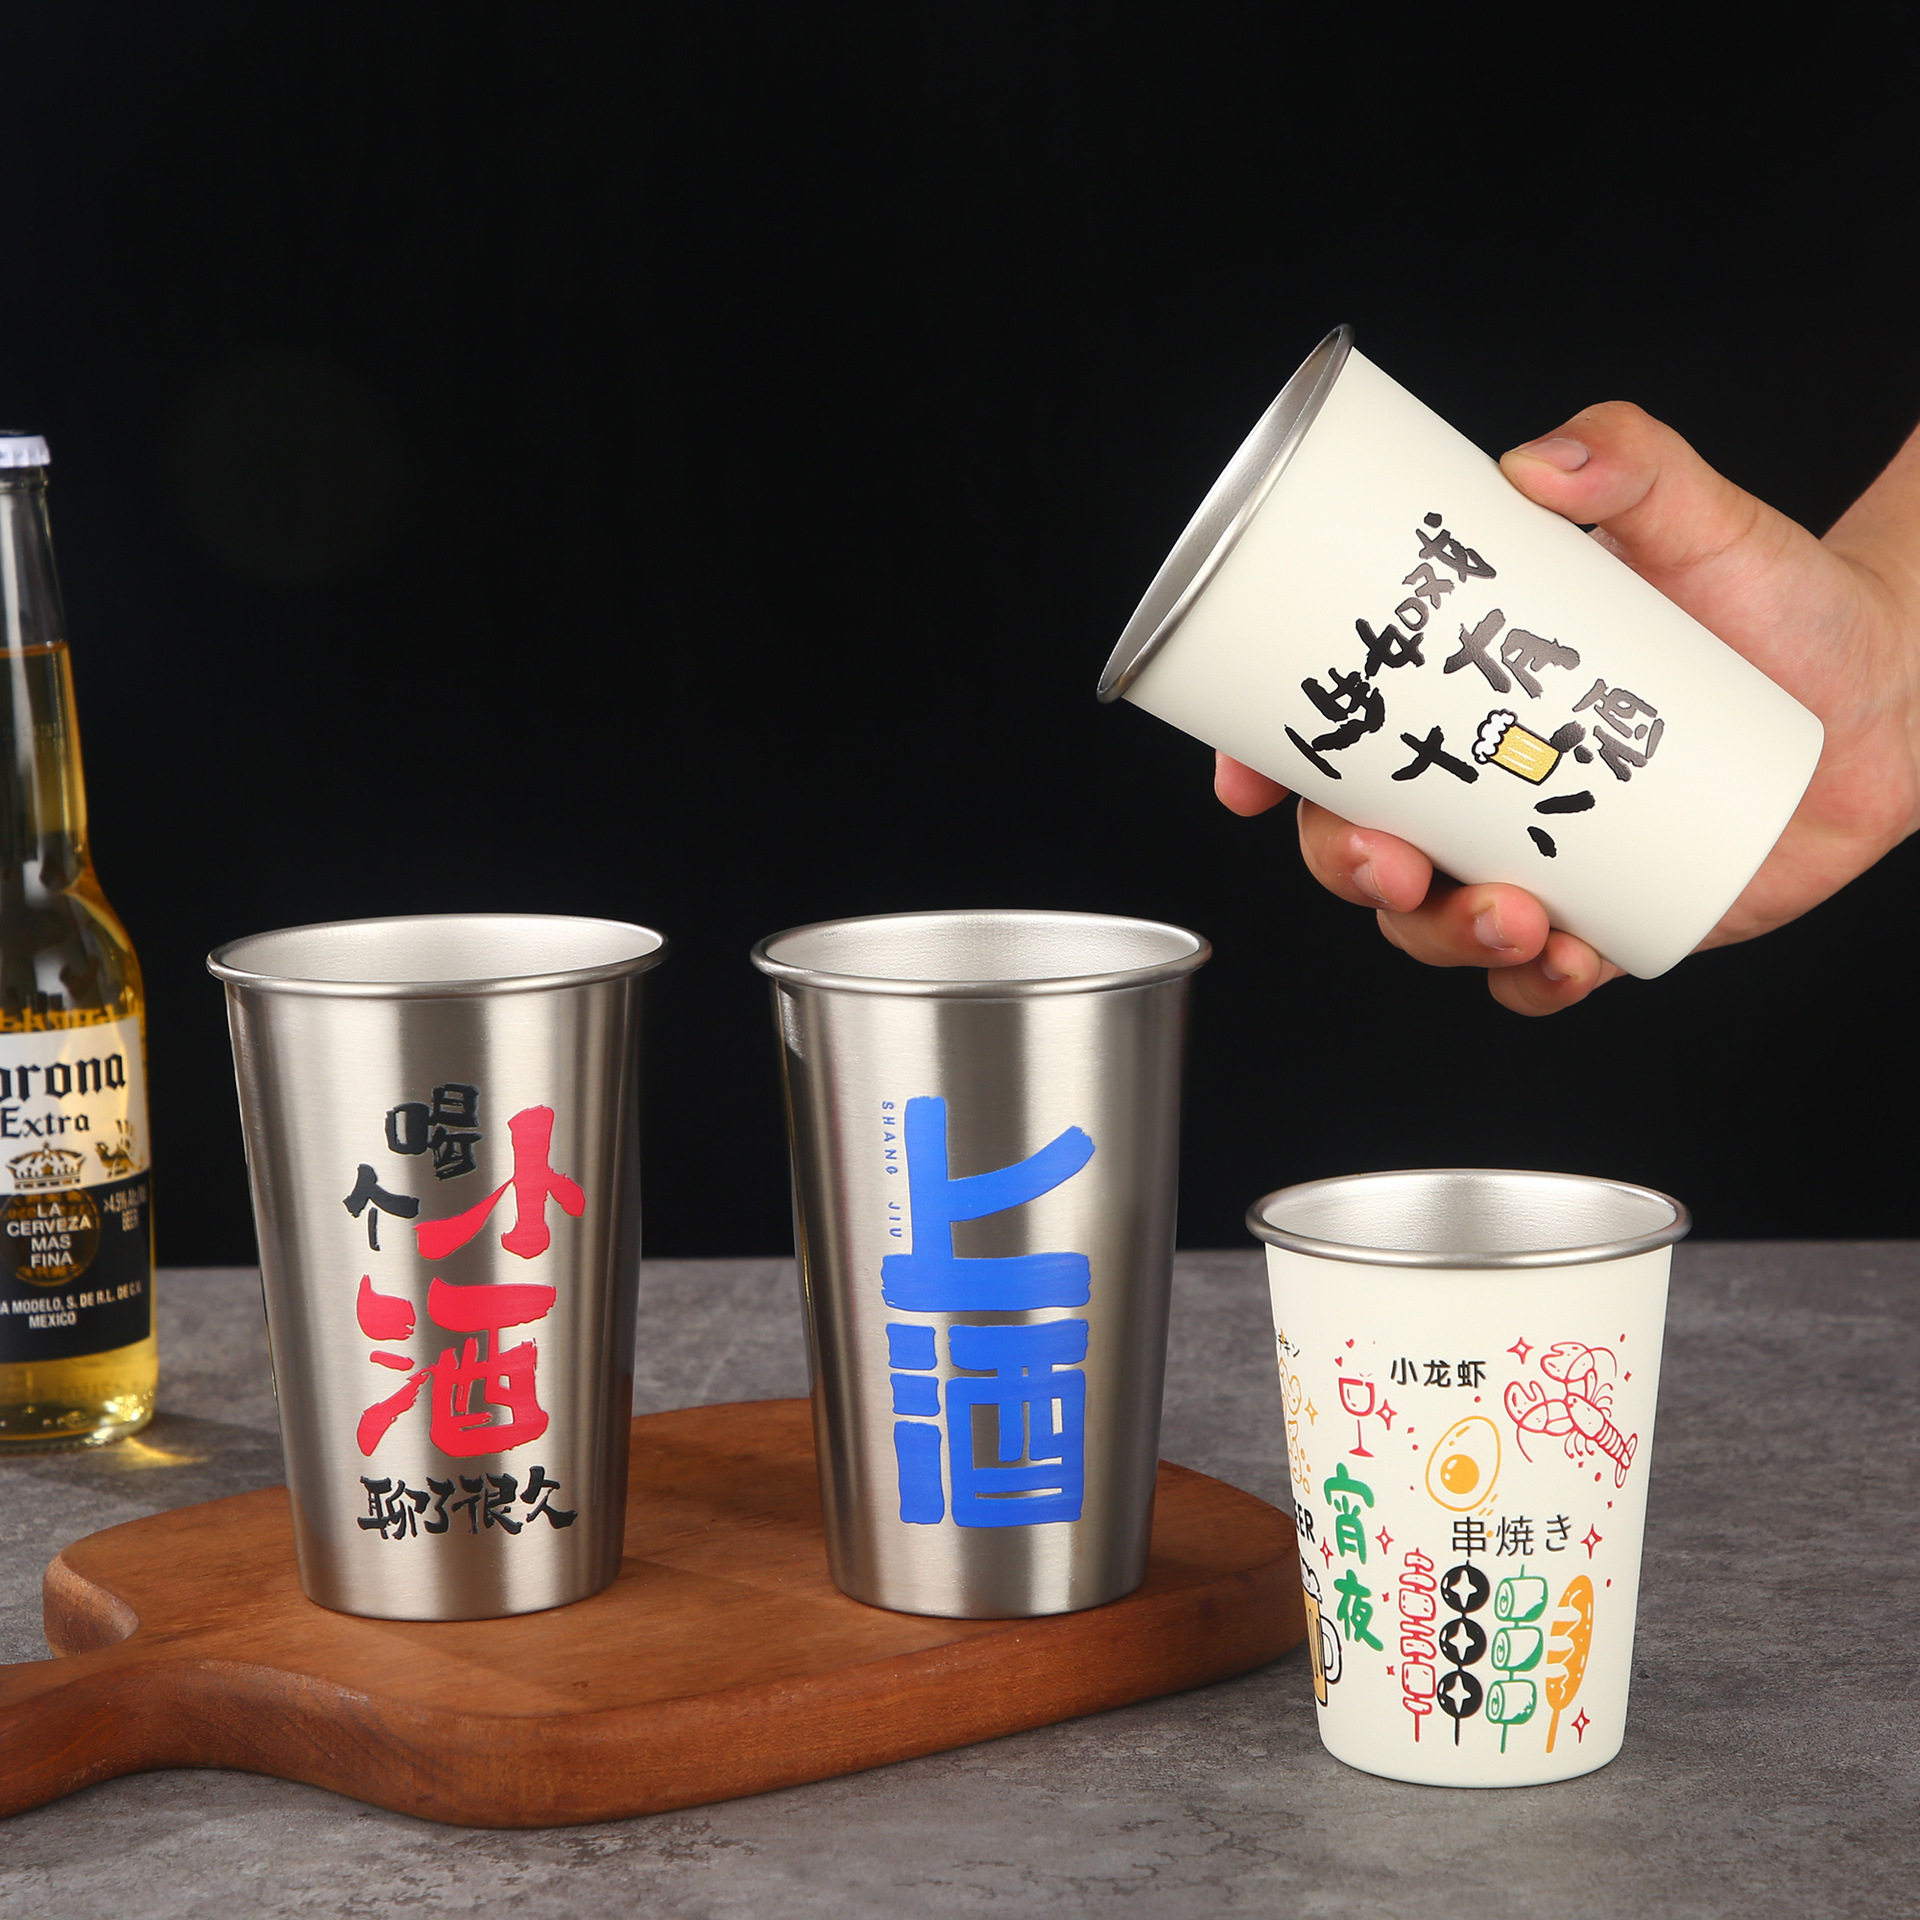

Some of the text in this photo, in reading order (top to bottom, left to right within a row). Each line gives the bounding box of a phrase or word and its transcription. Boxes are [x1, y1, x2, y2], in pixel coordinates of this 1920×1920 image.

[1284, 511, 1497, 781] 人生如戏
[1, 1106, 90, 1138] Extra
[881, 1100, 903, 1238] SHANG JIU
[7, 1214, 92, 1237] CERVEZA
[37, 1202, 61, 1218] LA
[31, 1234, 72, 1252] MAS
[31, 1251, 74, 1269] FINA
[66, 1295, 78, 1310] S.
[79, 1291, 95, 1308] DE
[881, 1095, 1096, 1528] 上酒
[29, 1310, 77, 1329] MEXICO
[1390, 1357, 1487, 1389] 小龙虾
[357, 1466, 579, 1541] 聊了很久
[1452, 1513, 1572, 1559] 串焼き
[1323, 1462, 1384, 1652] 宵夜
